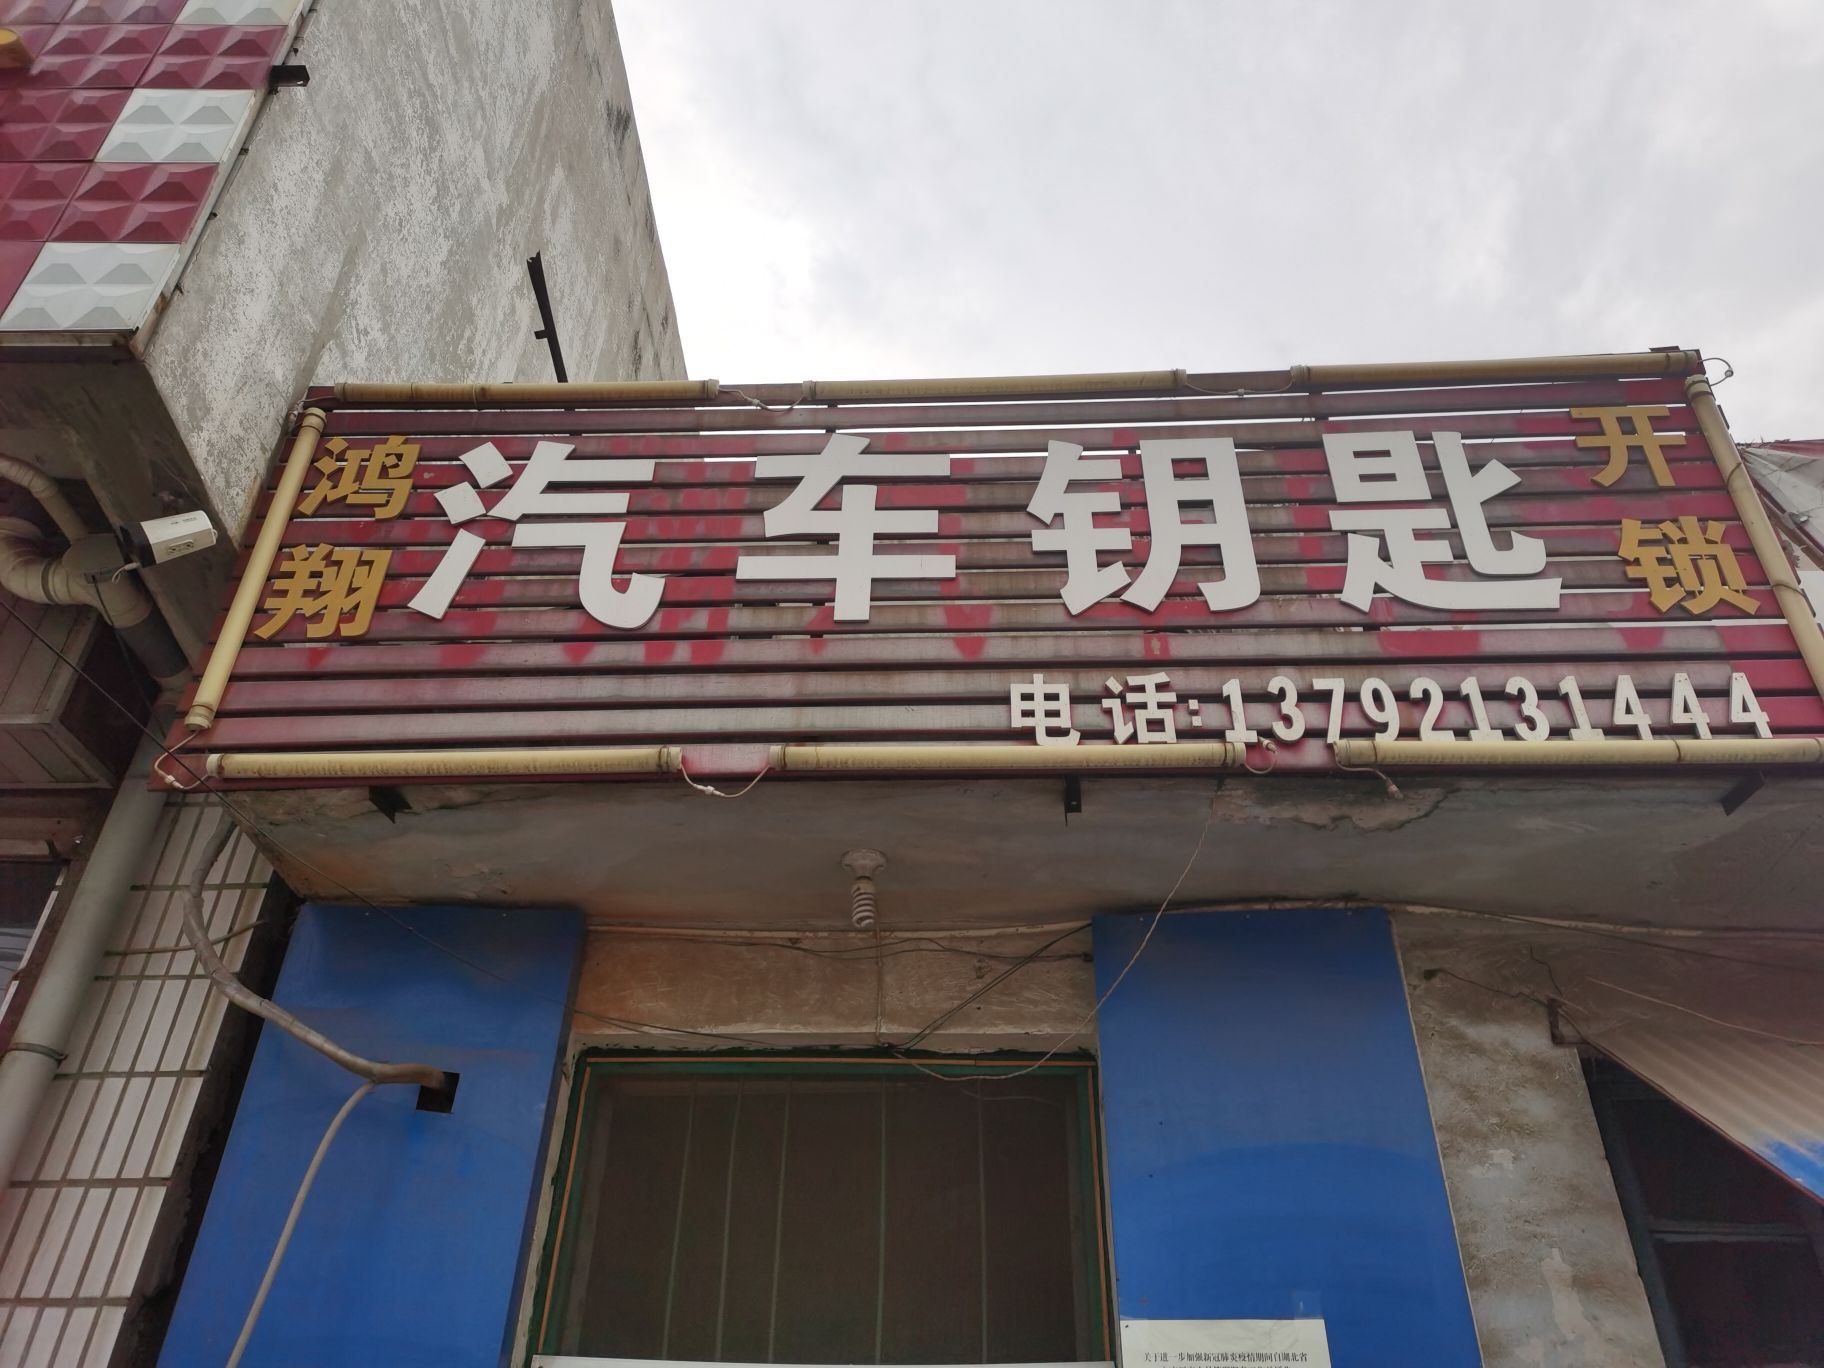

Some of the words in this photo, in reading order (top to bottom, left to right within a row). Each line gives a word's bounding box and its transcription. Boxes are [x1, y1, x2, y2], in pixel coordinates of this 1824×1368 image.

[254, 434, 422, 639] 鸿翔
[407, 430, 1563, 631] 汽车钥匙
[1569, 406, 1762, 615] 开锁
